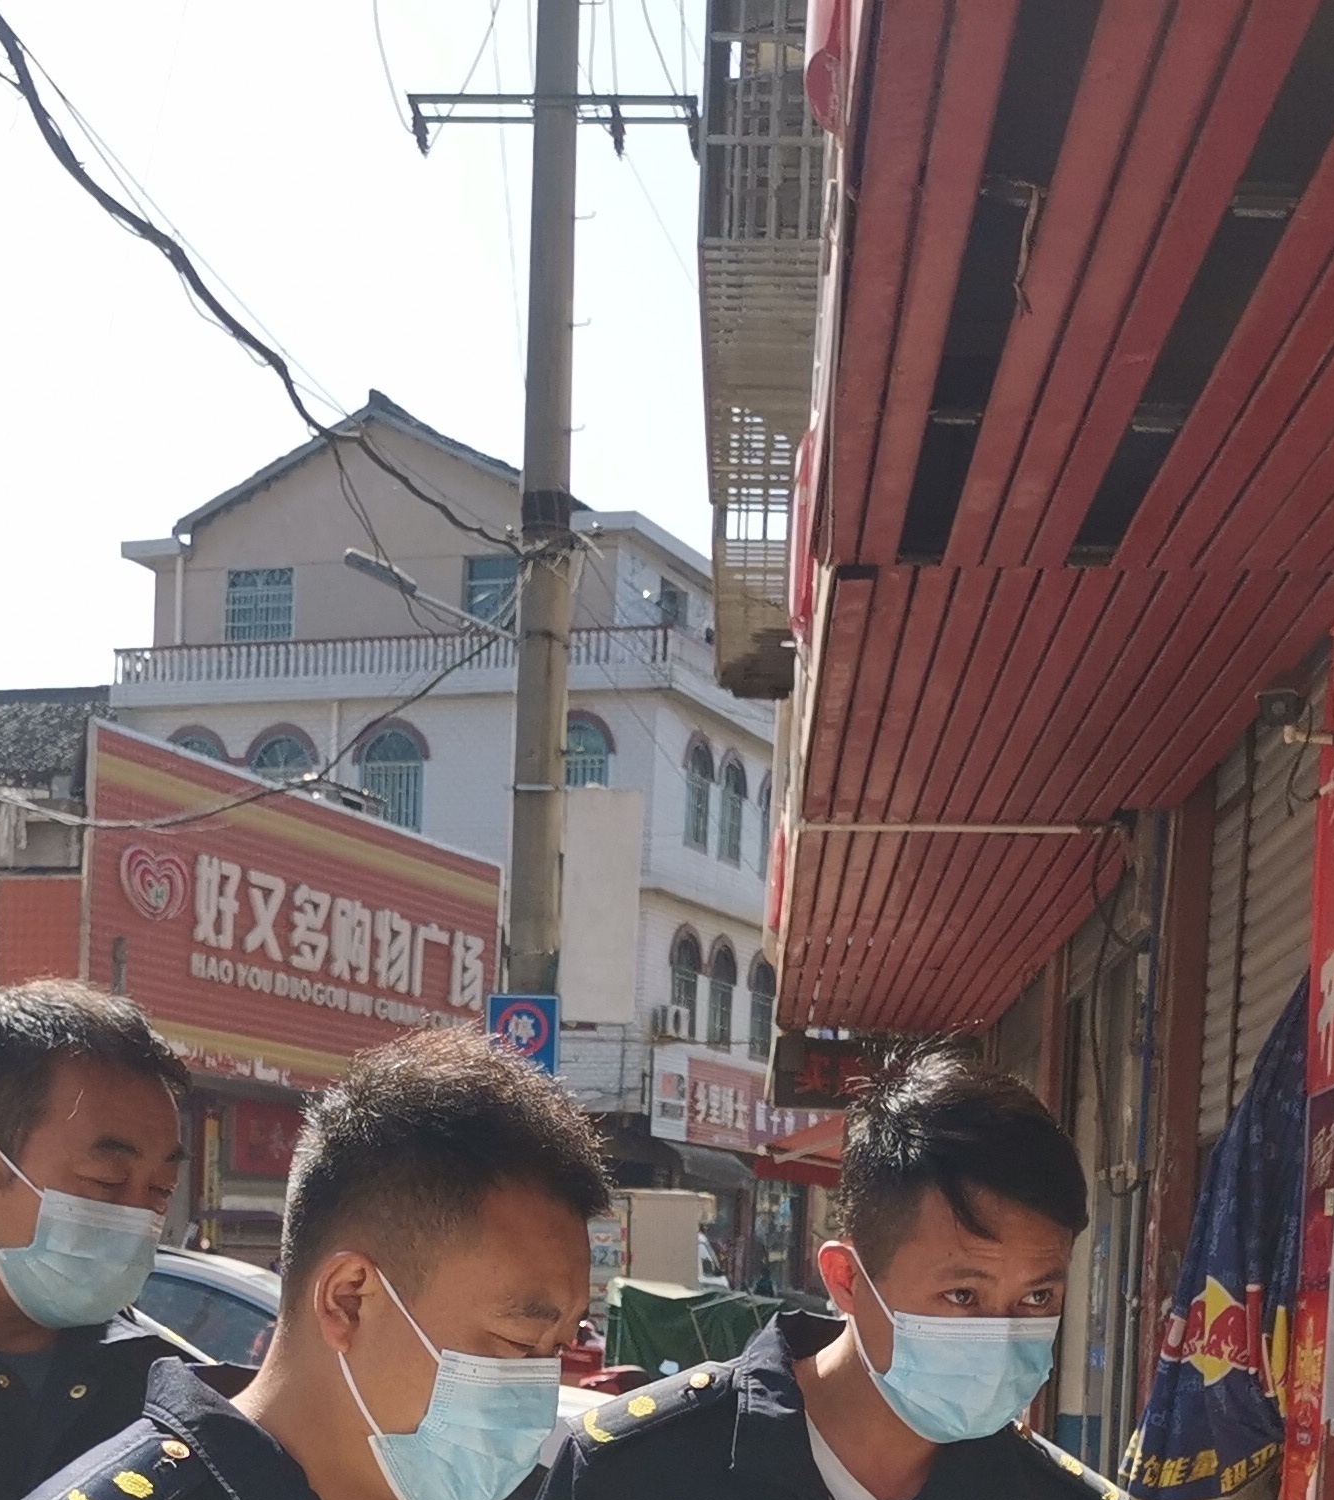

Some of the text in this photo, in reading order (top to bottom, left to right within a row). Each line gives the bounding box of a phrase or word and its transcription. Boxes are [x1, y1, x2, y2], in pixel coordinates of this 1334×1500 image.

[193, 854, 486, 1011] 好又多购物广场
